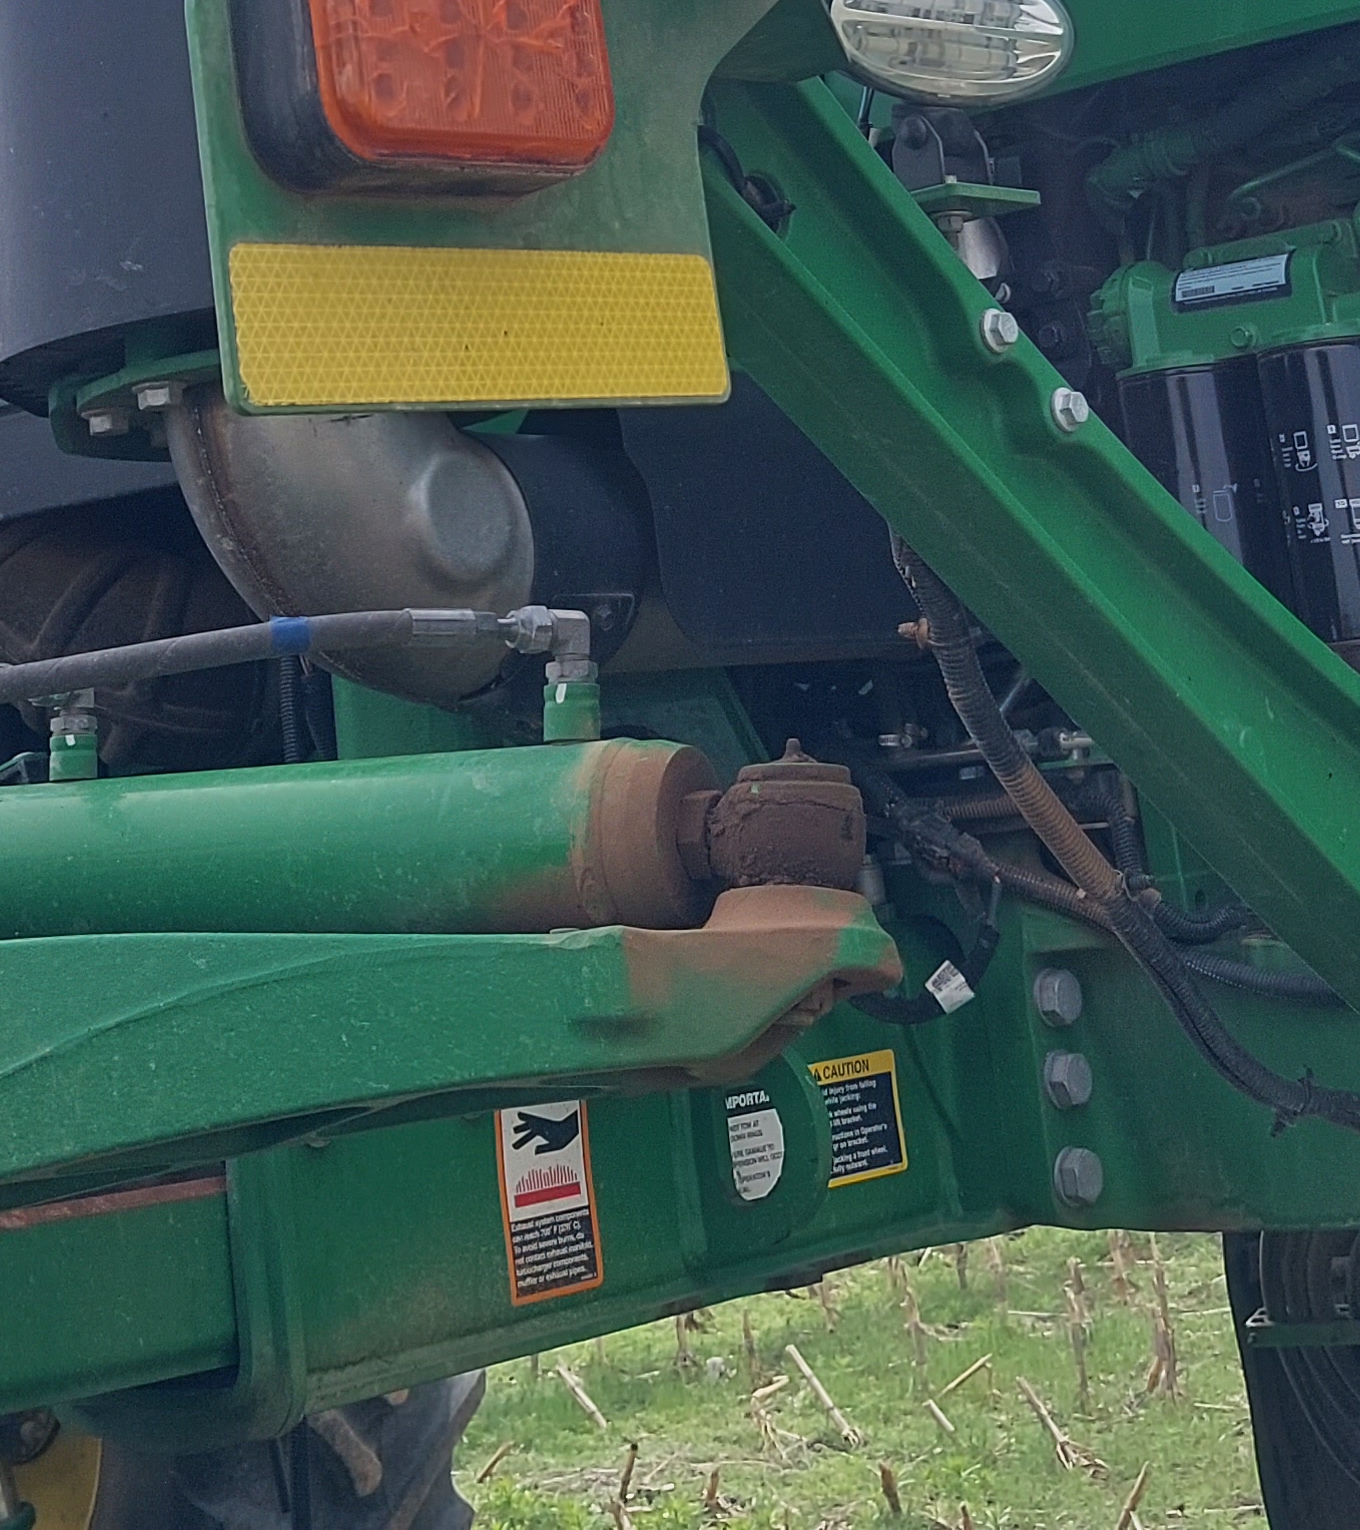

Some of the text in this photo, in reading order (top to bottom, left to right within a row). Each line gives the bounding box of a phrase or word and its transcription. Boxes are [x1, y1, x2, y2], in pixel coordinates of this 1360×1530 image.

[823, 1059, 870, 1080] CAUTION
[845, 1083, 858, 1091] from
[859, 1080, 877, 1089] falling
[556, 1209, 589, 1222] components
